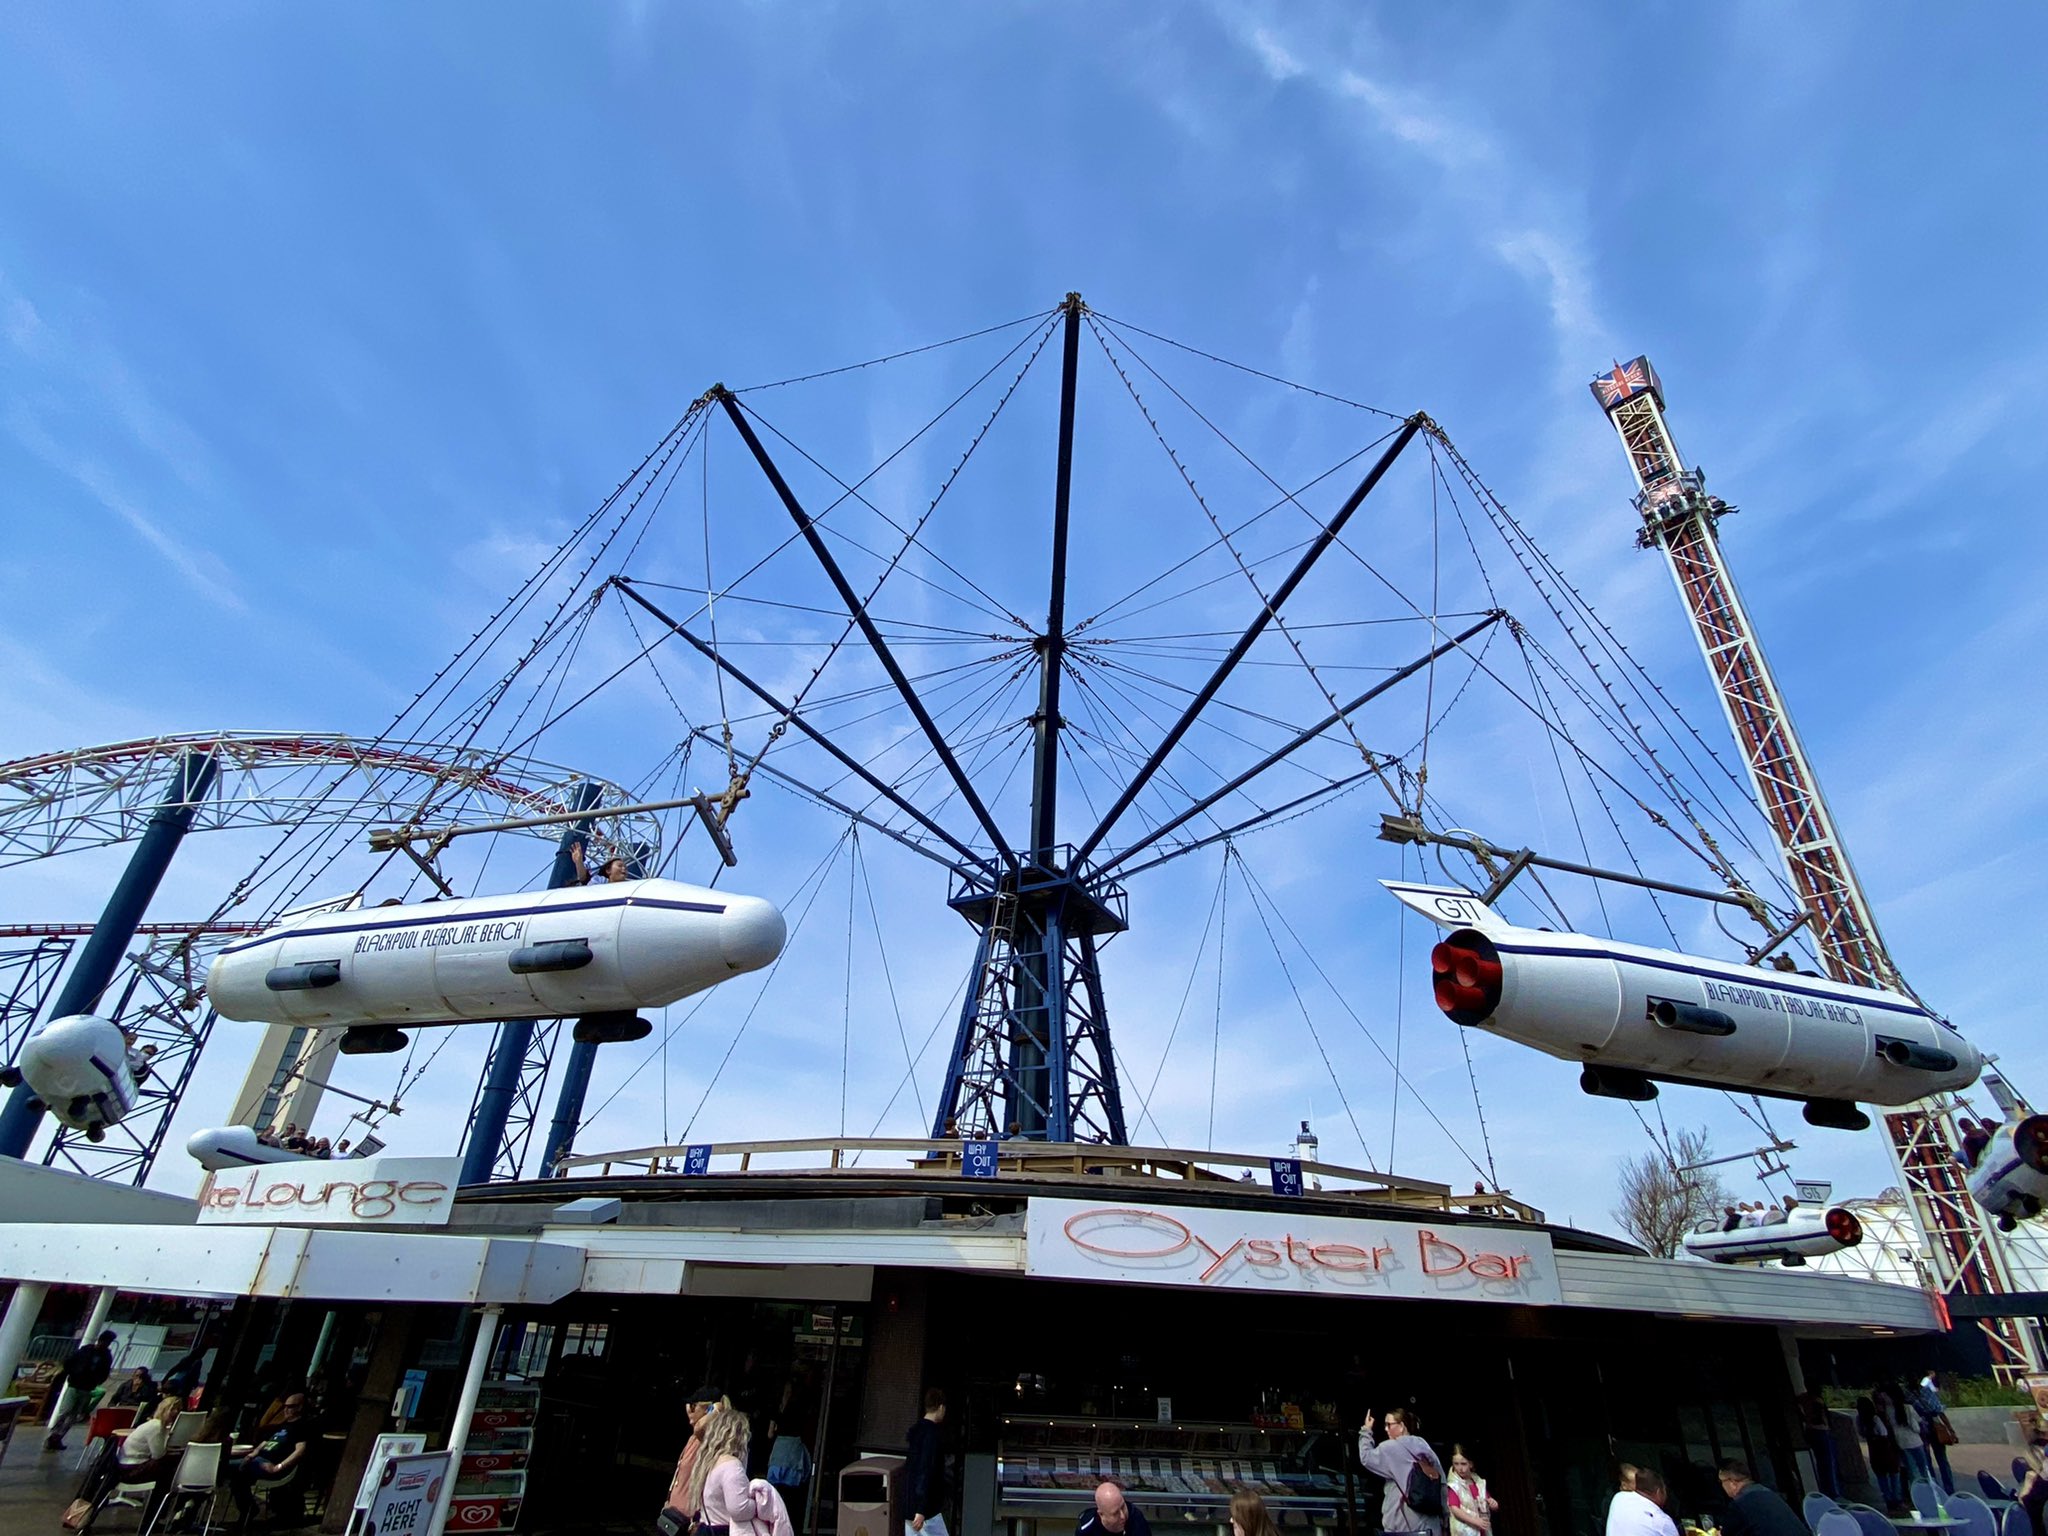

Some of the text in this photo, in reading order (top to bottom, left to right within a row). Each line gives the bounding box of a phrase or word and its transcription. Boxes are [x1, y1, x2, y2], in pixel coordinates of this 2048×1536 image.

[354, 921, 525, 954] BLACKPOOL PLEASURE BEACH
[1705, 981, 1864, 1027] BLACKPOOL PLEASURE BEACH
[689, 1148, 704, 1159] WAY
[968, 1144, 987, 1155] WAY
[690, 1158, 705, 1169] OUT
[972, 1155, 991, 1167] OUT
[1273, 1161, 1291, 1173] WAY
[1280, 1173, 1297, 1185] OUT
[244, 1168, 449, 1219] Lounge
[1063, 1207, 1531, 1280] Oyster Bar
[385, 1498, 422, 1517] RIGHT
[380, 1512, 418, 1534] HERE
